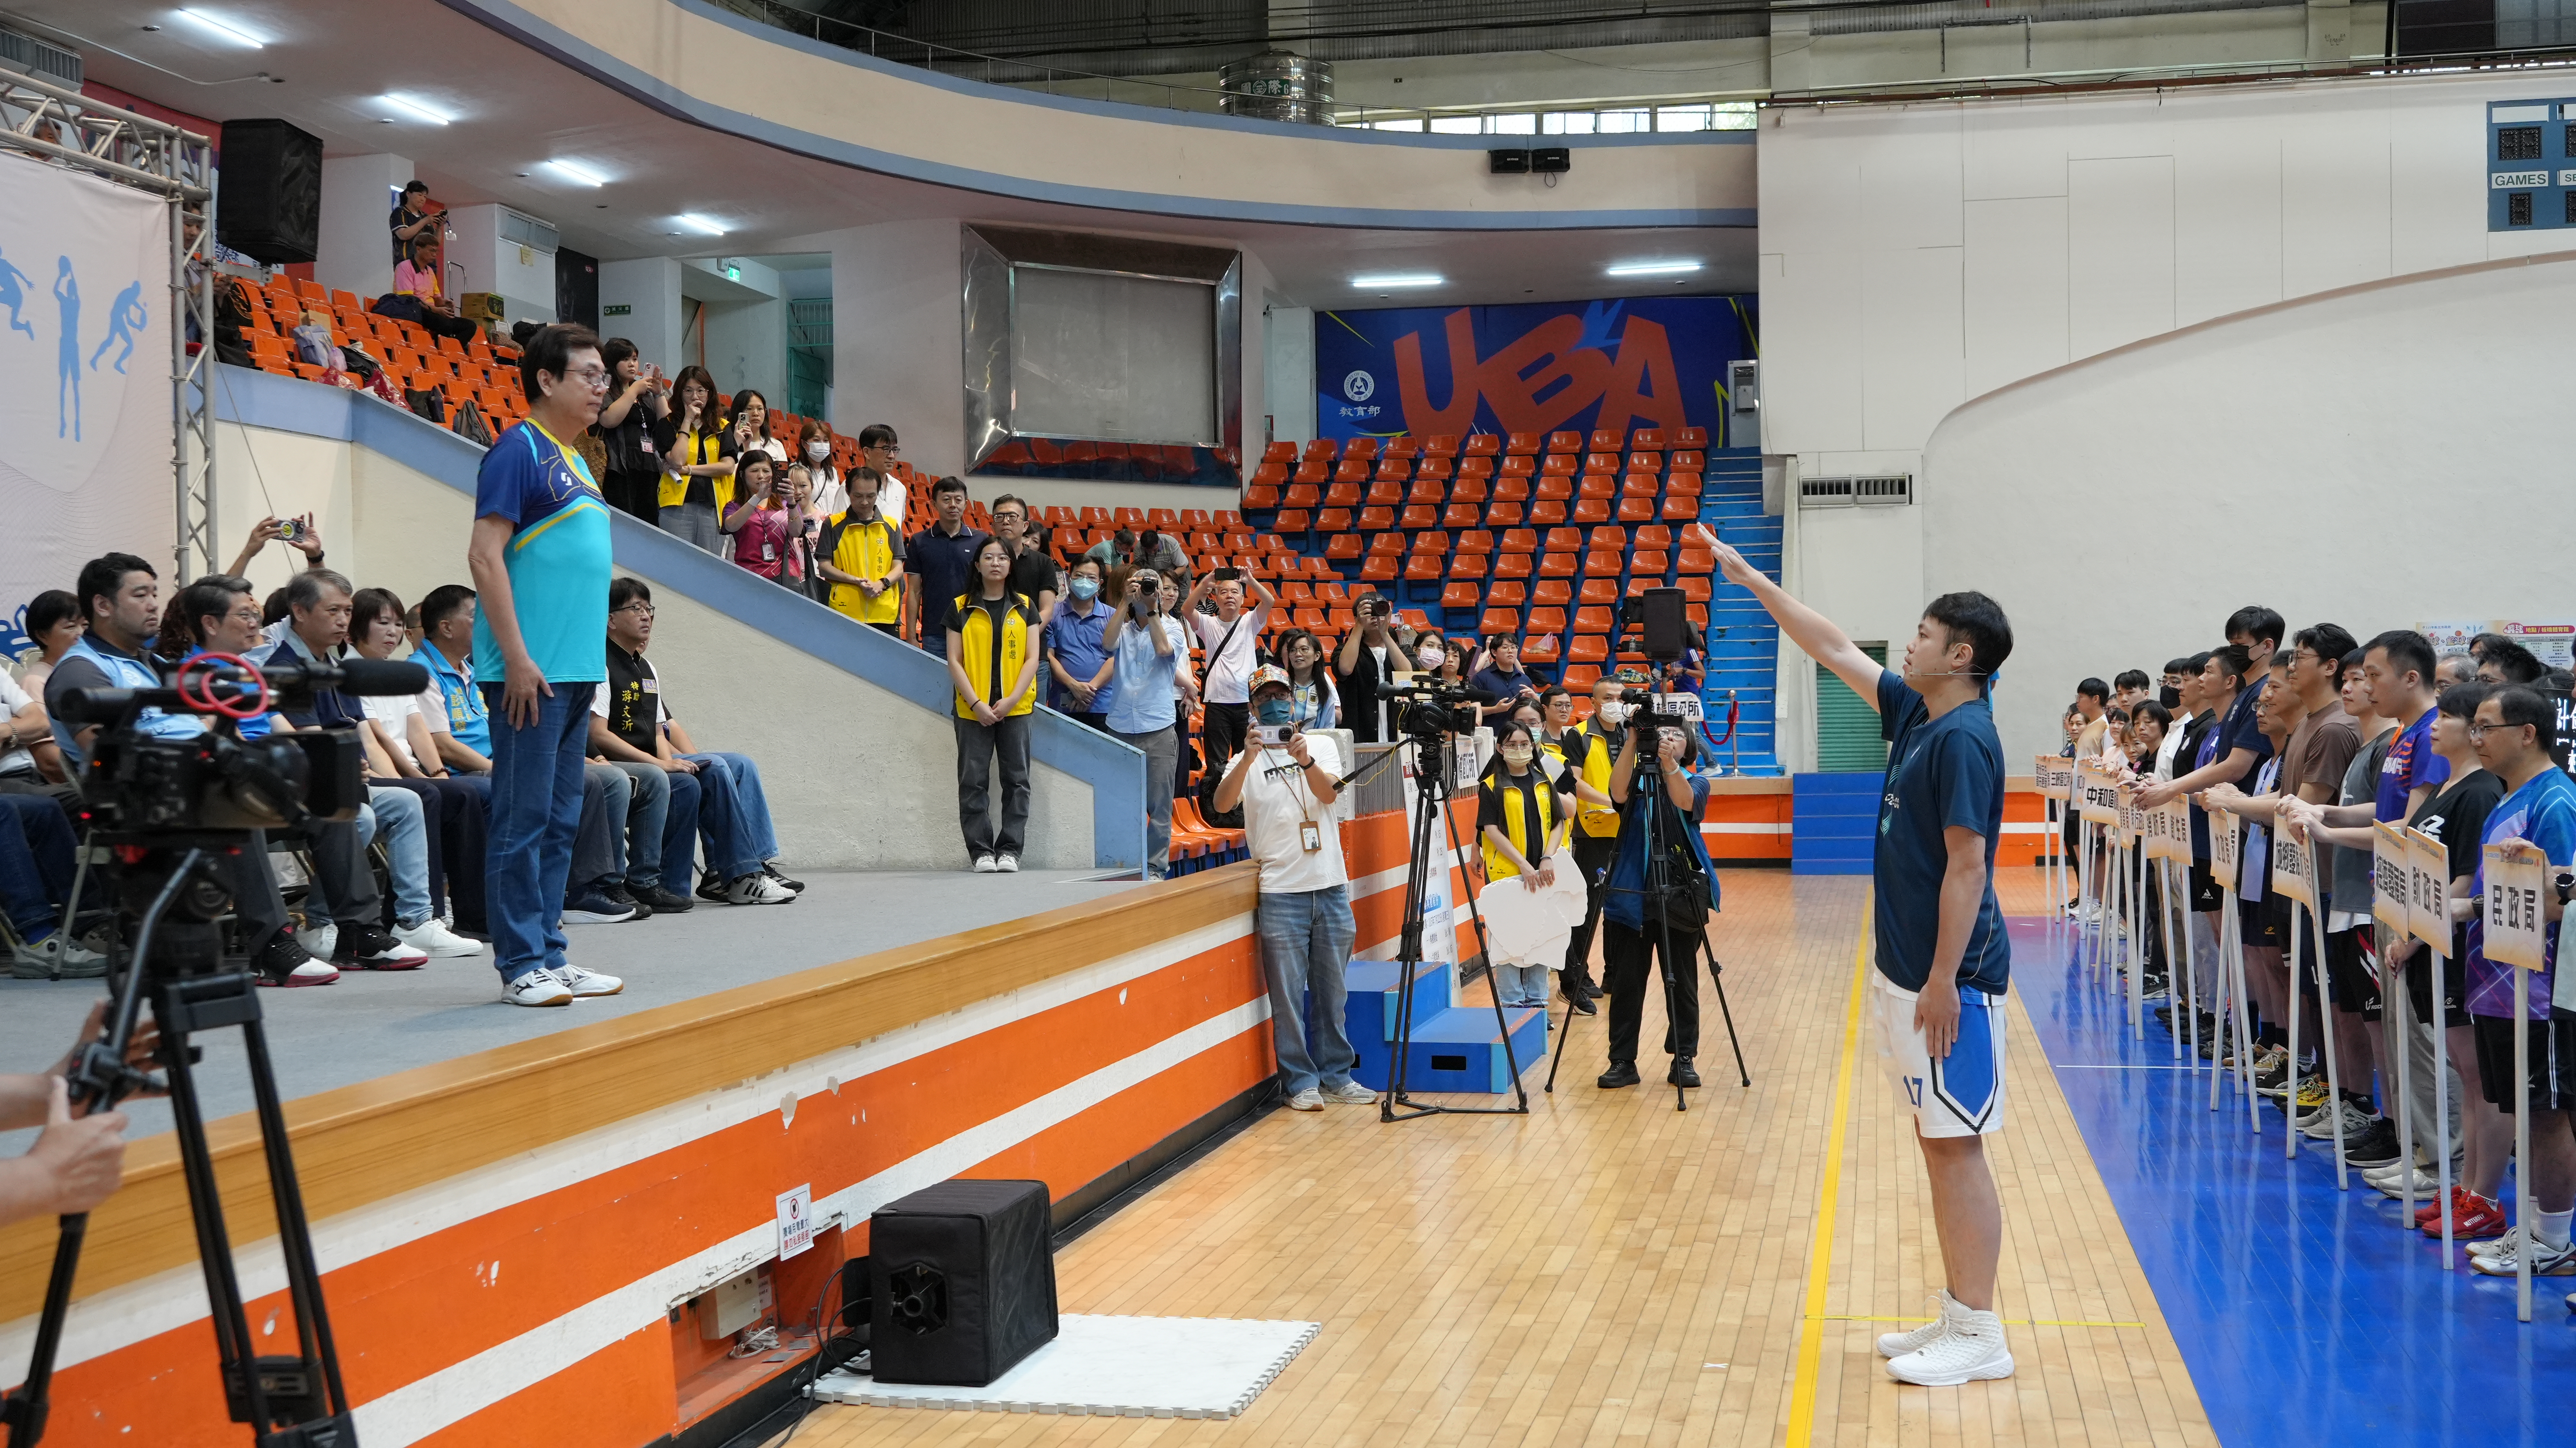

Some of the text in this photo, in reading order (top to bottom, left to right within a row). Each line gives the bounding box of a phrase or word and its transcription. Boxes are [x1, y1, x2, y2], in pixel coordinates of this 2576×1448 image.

[2495, 174, 2546, 186] GAMES
[1345, 375, 1354, 394] MINISTRY
[1393, 307, 1687, 445] UBA
[1339, 405, 1381, 417] 教育部
[1008, 630, 1016, 659] 人事處
[630, 681, 640, 701] 特助
[2146, 811, 2166, 838] 消防局
[2376, 853, 2406, 909] 經濟發展局
[2413, 865, 2442, 920] 財政局
[2493, 884, 2536, 932] 民政局
[1903, 1075, 1923, 1108] 17
[2463, 1212, 2485, 1227] BUTTERFLY
